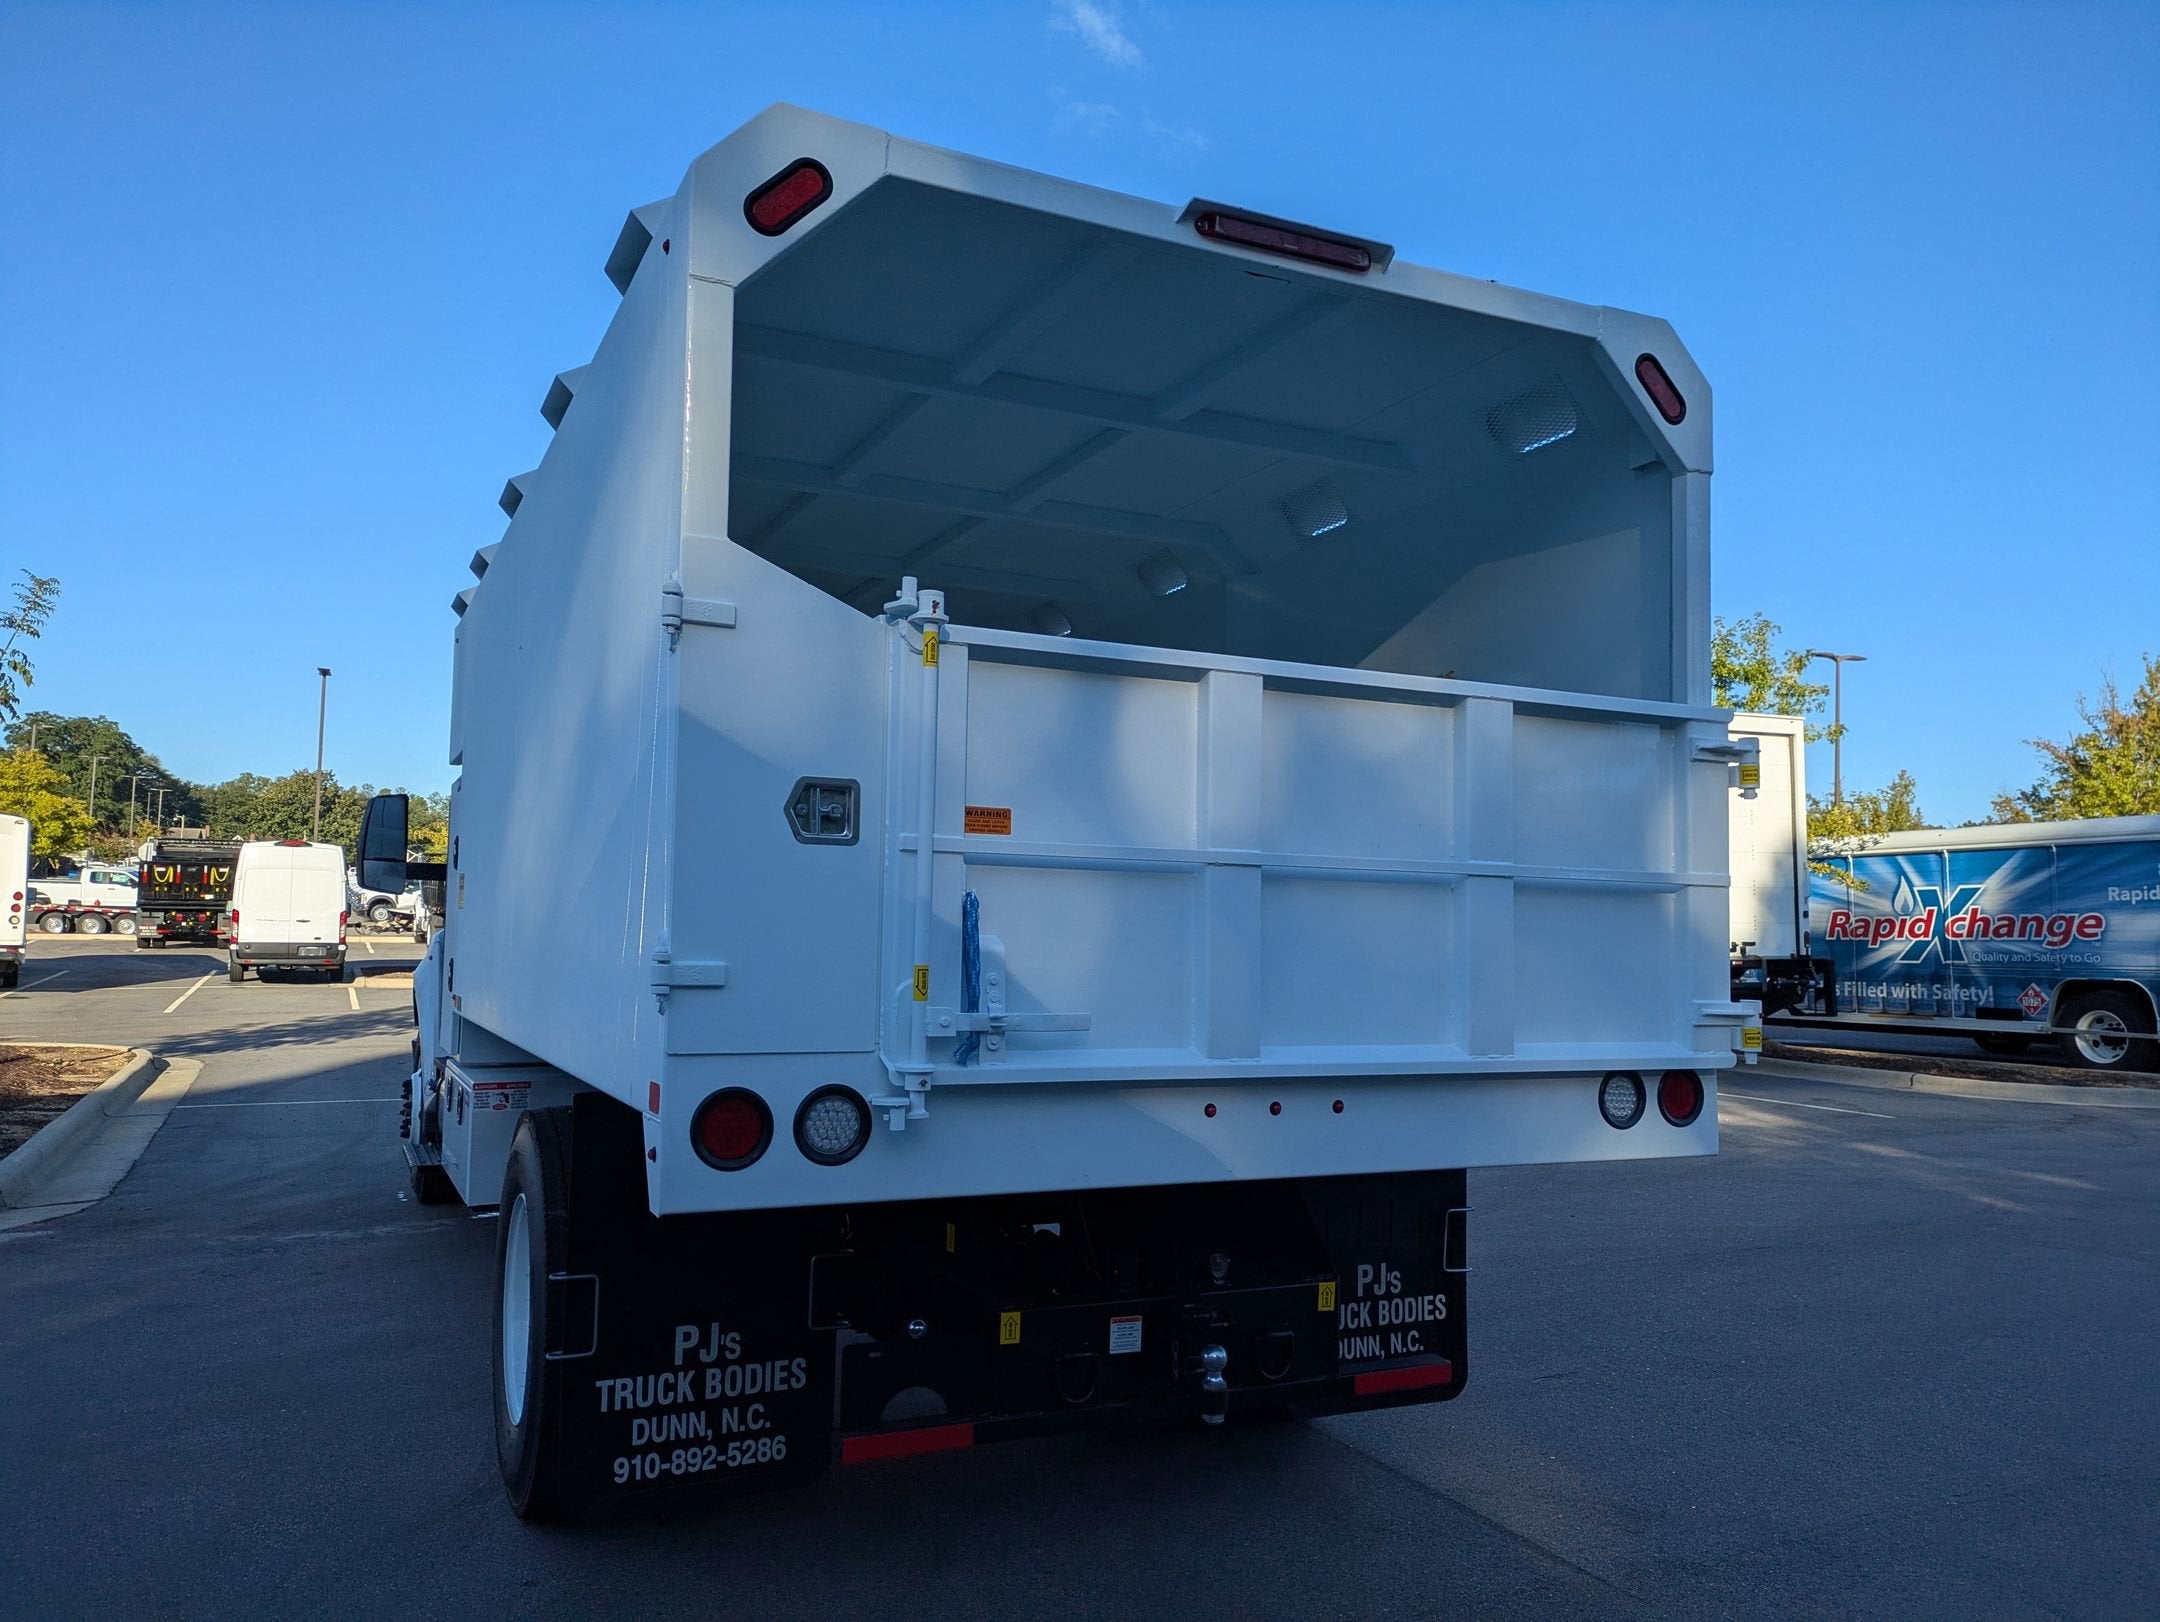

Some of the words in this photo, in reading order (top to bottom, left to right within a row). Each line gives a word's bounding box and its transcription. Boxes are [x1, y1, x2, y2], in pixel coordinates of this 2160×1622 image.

[965, 809, 1008, 818] WARNING
[2107, 884, 2160, 904] Rapid
[1827, 908, 1937, 948] Rapid
[1944, 907, 2105, 948] change
[1973, 952, 2009, 964] Quality
[2011, 951, 2031, 962] and
[2034, 951, 2067, 964] Safety
[2070, 953, 2081, 963] to
[2084, 953, 2101, 963] Go
[1844, 981, 1887, 998] Filled
[1891, 983, 1927, 1000] with
[1932, 983, 1994, 1006] Safety!
[1357, 1262, 1401, 1297] PJ's
[1378, 1294, 1446, 1326] BODIES
[674, 1322, 741, 1366] PJ's
[1390, 1330, 1424, 1354] N.C.
[595, 1370, 696, 1413] TRUCK
[705, 1357, 807, 1400] BODIES
[631, 1410, 713, 1446] DUNN,
[721, 1403, 771, 1434] N.C.
[613, 1435, 787, 1484] 910-892-5286
